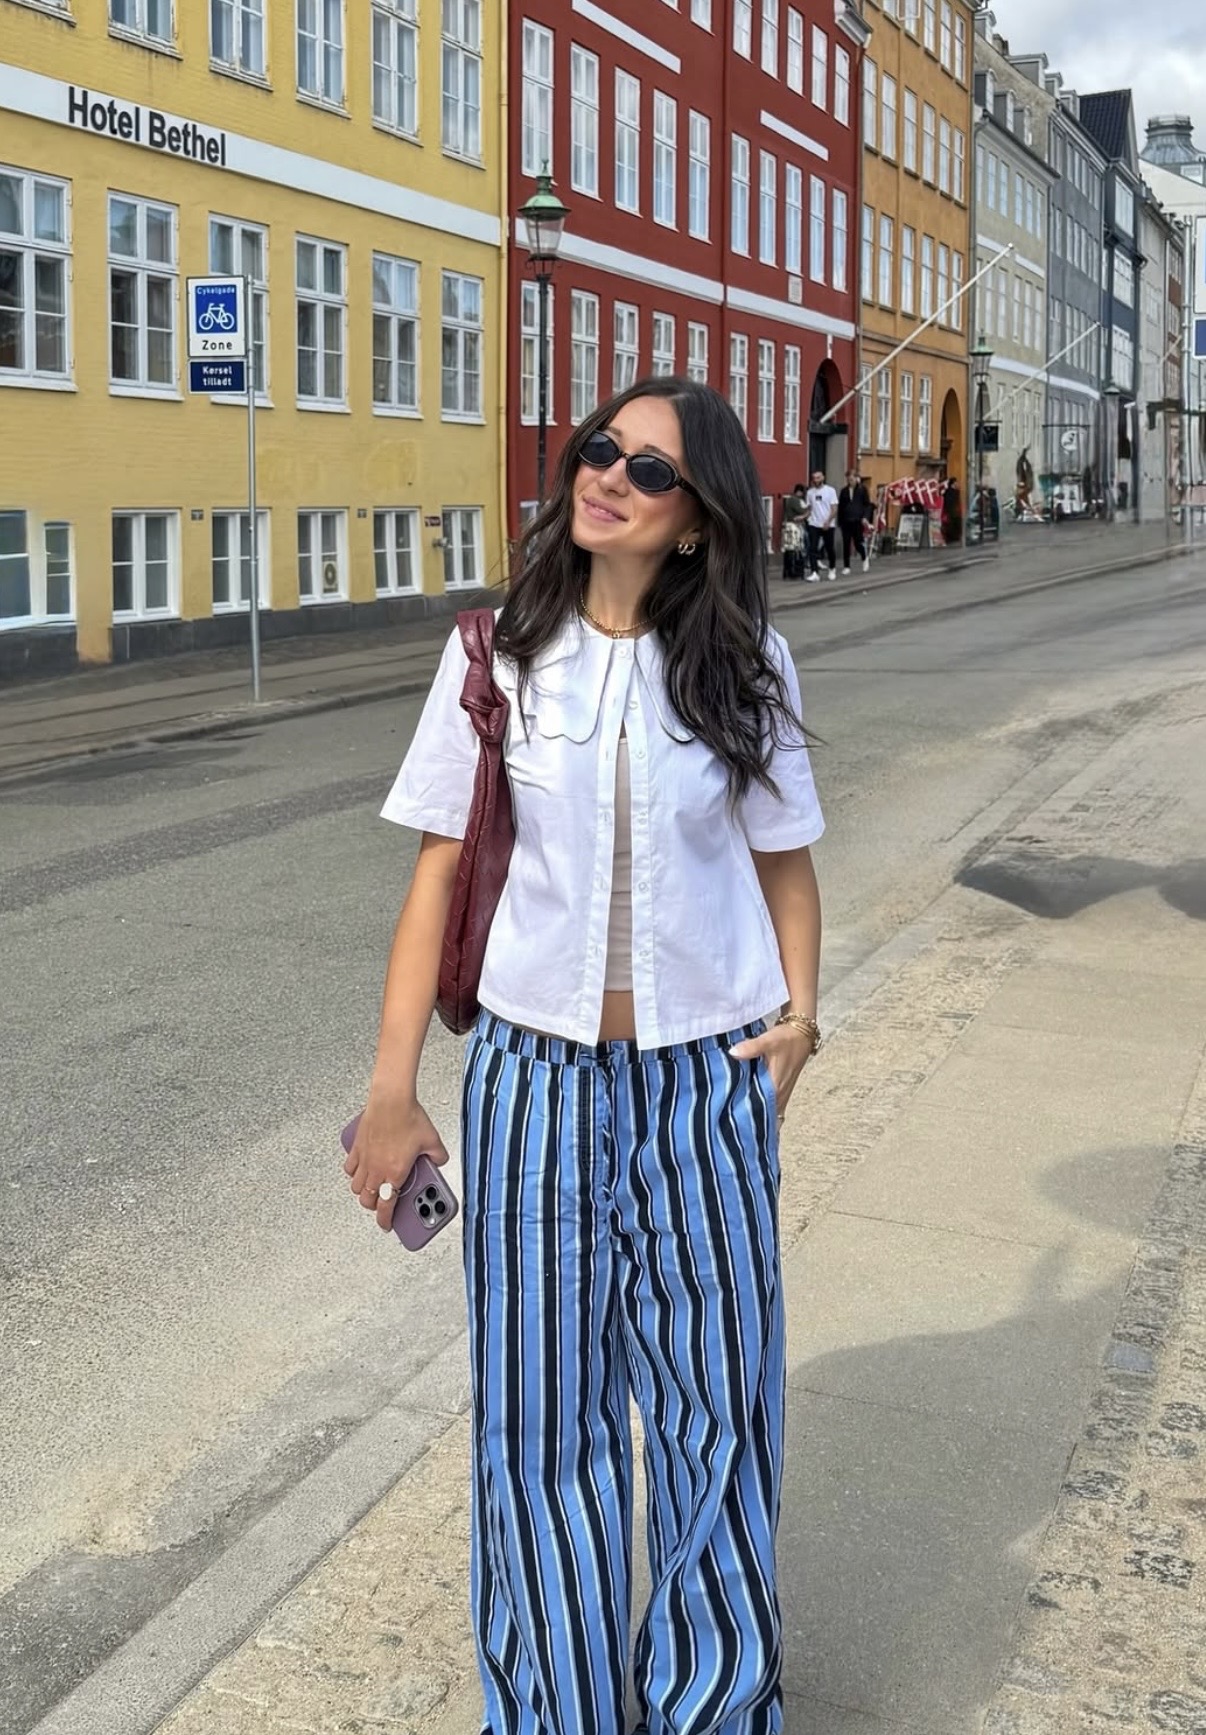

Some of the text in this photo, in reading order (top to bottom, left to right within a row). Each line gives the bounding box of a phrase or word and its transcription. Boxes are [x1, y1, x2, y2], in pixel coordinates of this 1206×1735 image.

[68, 86, 226, 166] Hotel Bethel
[202, 340, 233, 351] Zone
[203, 377, 232, 386] tilladt
